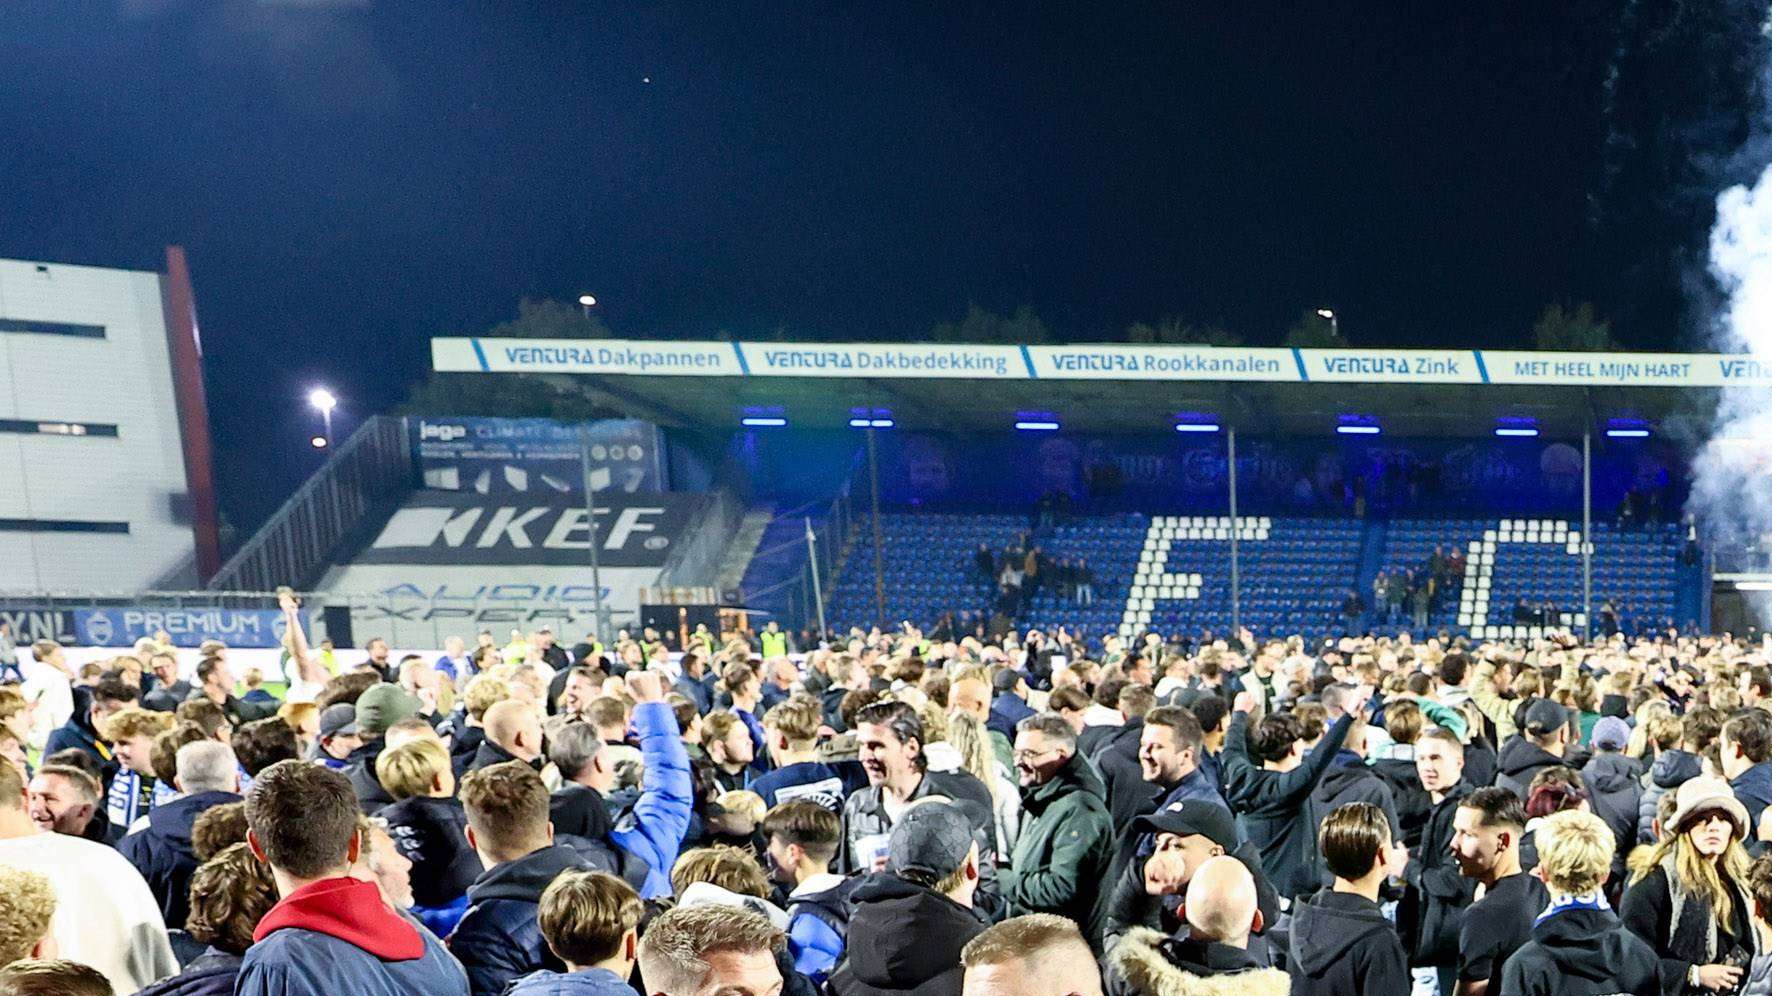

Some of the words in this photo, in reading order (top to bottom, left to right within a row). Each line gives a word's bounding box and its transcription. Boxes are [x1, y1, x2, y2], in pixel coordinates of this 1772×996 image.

[505, 347, 595, 365] VENTURA
[598, 349, 721, 370] Dakpannen
[765, 351, 853, 369] VENTURA
[858, 352, 1007, 375] Dakbedekking
[1052, 354, 1139, 371] VENTURA
[1144, 355, 1280, 373] Rookkanalen
[1324, 357, 1409, 374] VENTURA
[1415, 357, 1459, 375] Zink
[1514, 361, 1551, 377] MET
[1554, 361, 1596, 377] HEEL
[1599, 362, 1640, 382] MIJN
[1644, 363, 1691, 378] HART
[476, 507, 666, 550] KEF
[123, 611, 260, 634] PREMIUM
